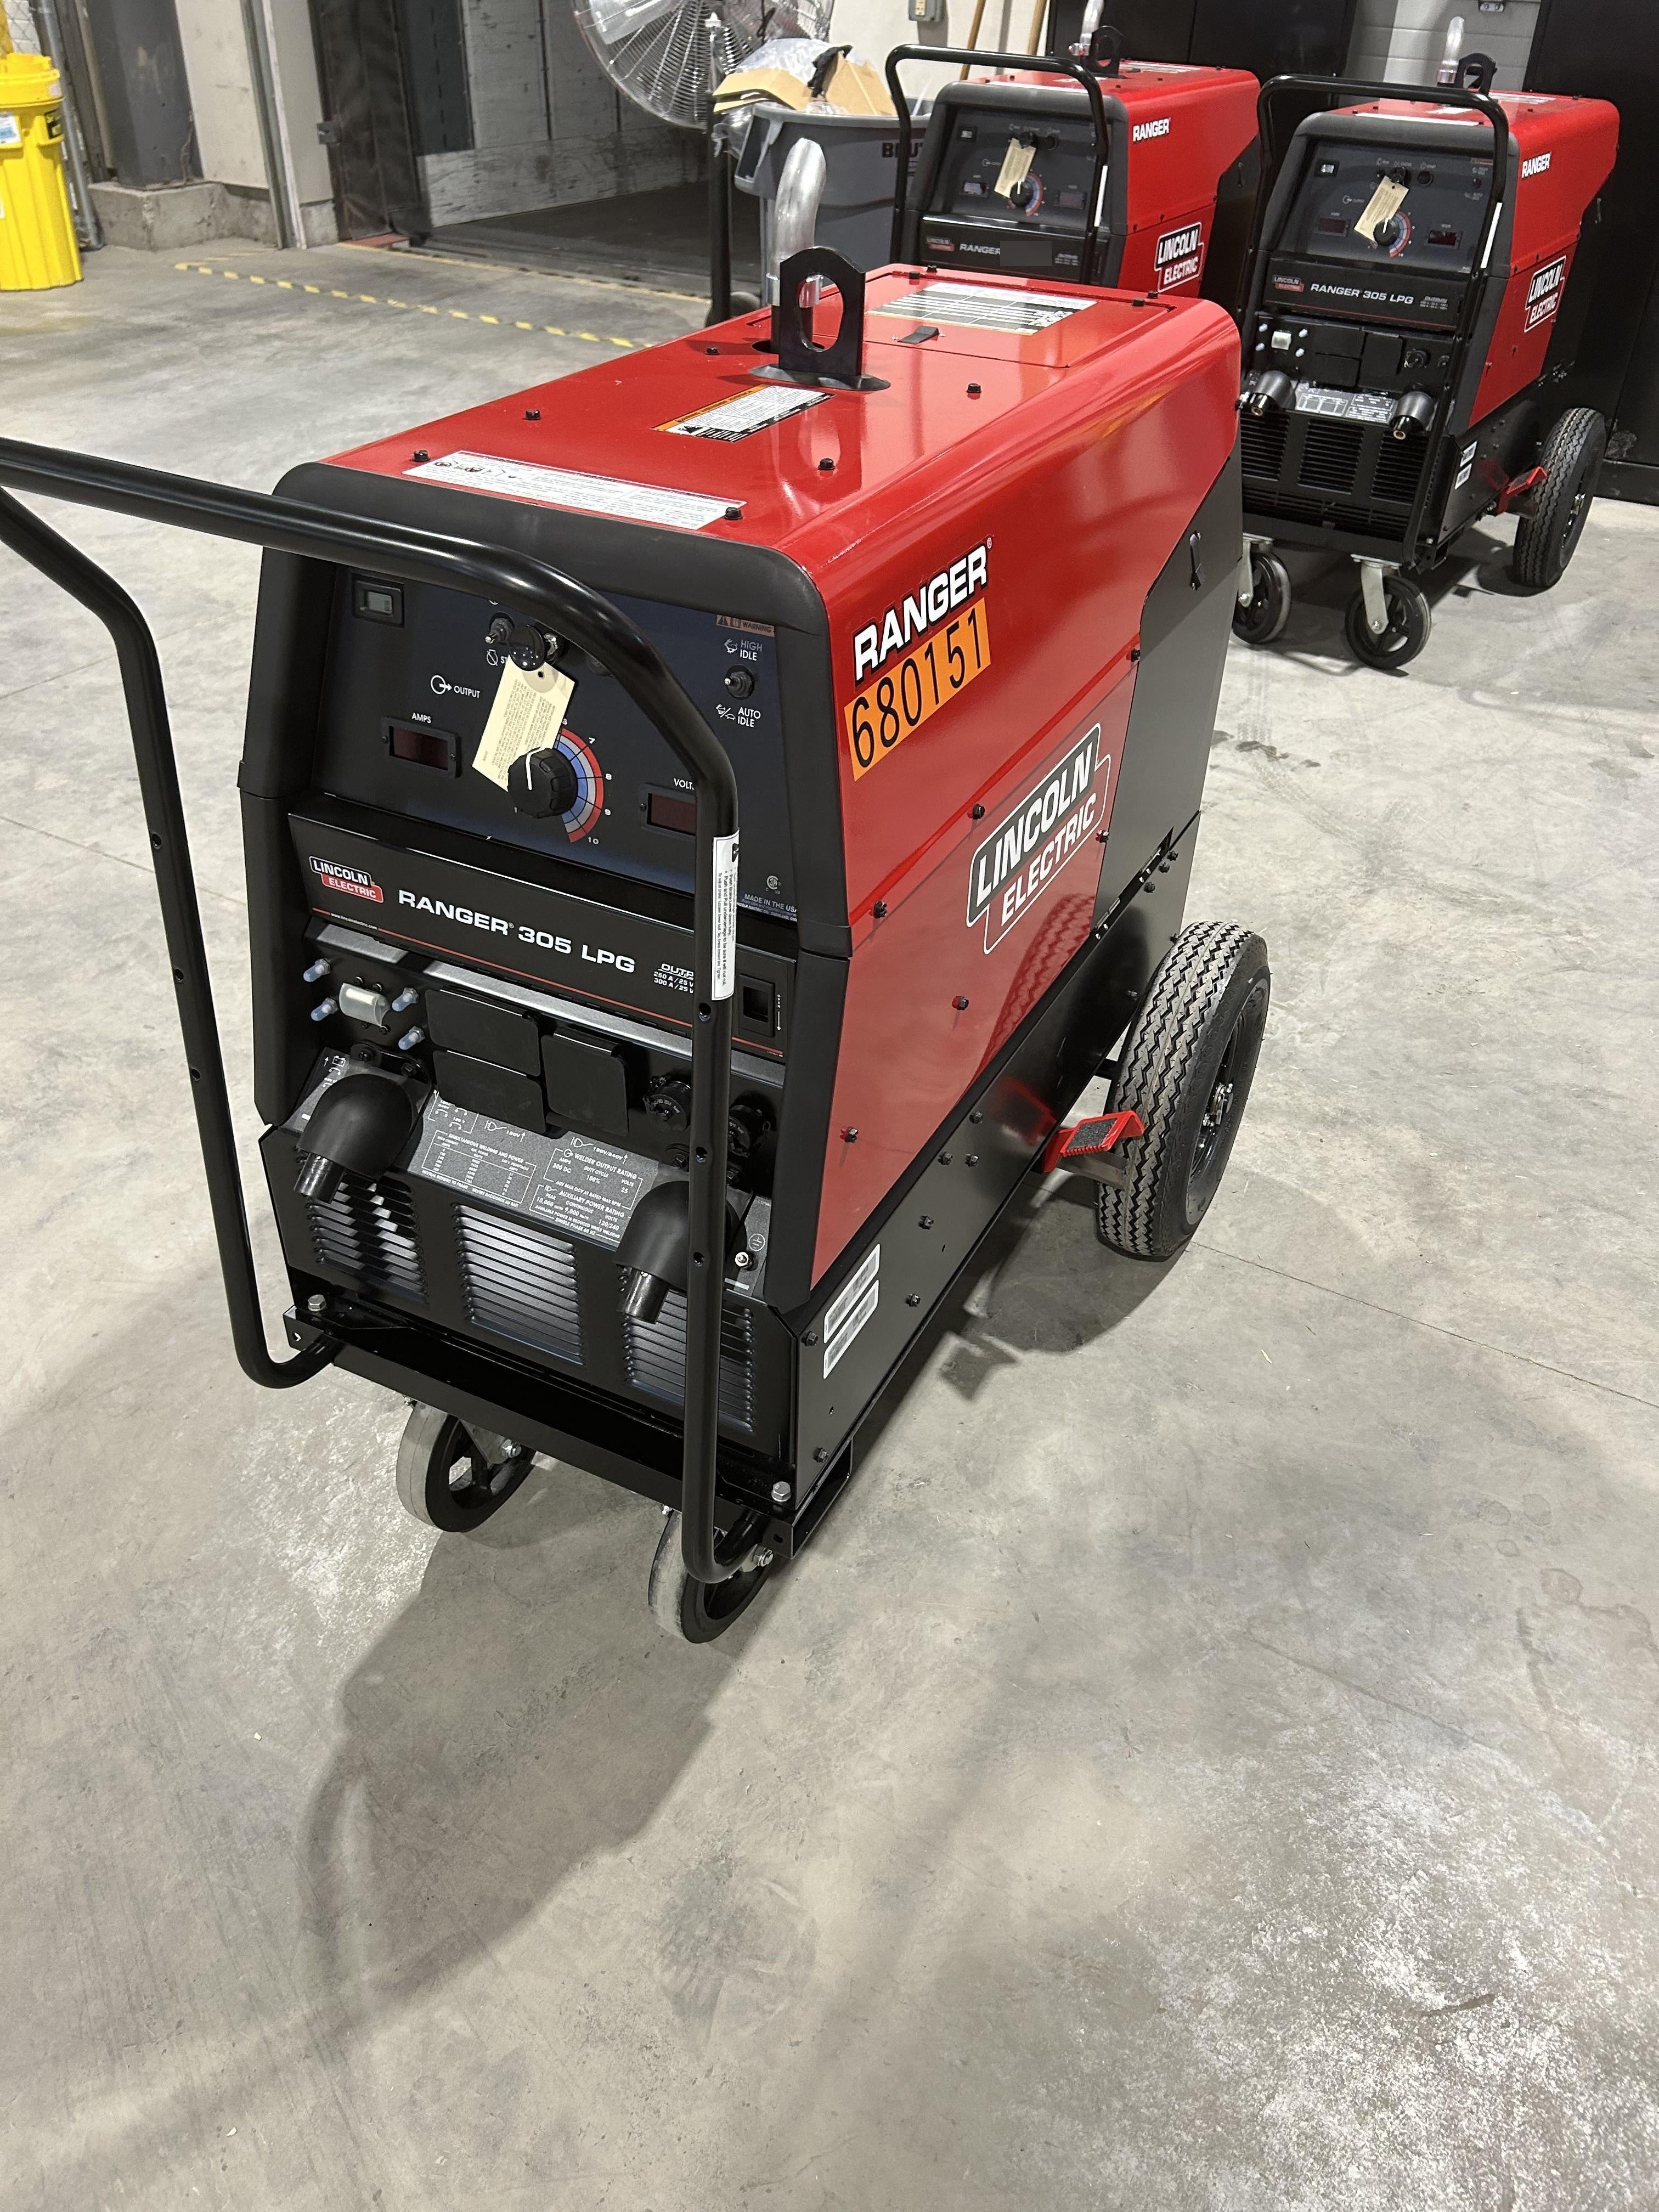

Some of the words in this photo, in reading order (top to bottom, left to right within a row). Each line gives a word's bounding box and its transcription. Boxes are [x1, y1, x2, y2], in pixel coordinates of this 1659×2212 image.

[1133, 119, 1169, 142] RANGER
[1521, 154, 1550, 178] RANGER
[1158, 229, 1199, 264] LINCOLN
[1164, 257, 1198, 285] ELECTRIC
[1528, 264, 1562, 303] LINCOLN
[1310, 284, 1361, 297] RANGER
[1363, 291, 1387, 300] 305
[1390, 294, 1414, 304] LPG
[1529, 292, 1558, 324] ELECTRIC
[854, 545, 987, 681] RANGER
[742, 620, 771, 633] WARNING
[741, 640, 763, 652] HIGH
[740, 649, 758, 661] IDLE
[454, 685, 481, 698] OUTPUT
[852, 609, 981, 768] 680151
[412, 713, 431, 724] AMPS
[738, 707, 761, 719] AUTO
[737, 716, 754, 727] IDLE
[674, 778, 695, 791] VOLT
[977, 742, 1092, 907] LINCOLN
[588, 836, 599, 845] 10
[1001, 792, 1097, 927] ELECTRIC
[313, 860, 368, 885] LINCOLN
[329, 877, 376, 898] ELECTRIC
[744, 894, 763, 904] MADE
[772, 901, 785, 909] THE
[399, 889, 509, 935] RANGER
[518, 926, 572, 954] 305
[581, 944, 635, 973] LPG
[653, 971, 667, 979] 250
[661, 963, 693, 977] OUTP
[653, 978, 668, 986] 300
[508, 1154, 524, 1164] POWER
[552, 1163, 563, 1171] 300
[574, 1153, 596, 1165] WELDER
[596, 1161, 617, 1172] OUTPUT
[617, 1169, 637, 1180] RATING
[586, 1175, 600, 1184] 100%
[595, 1170, 610, 1178] CYCLE
[621, 1179, 634, 1187] VOLTS
[536, 1197, 554, 1207] 10,000
[558, 1190, 586, 1204] AUXILIARY
[585, 1199, 605, 1211] POWER
[605, 1207, 625, 1218] RATING
[566, 1200, 594, 1214] CONTINUOUS
[565, 1207, 580, 1216] 9,000
[605, 1214, 618, 1223] VOLTS
[534, 1205, 554, 1215] AVAILABLE
[554, 1211, 568, 1220] POWER
[573, 1218, 590, 1227] REDUCED
[603, 1228, 620, 1238] WELDING
[555, 1217, 570, 1226] SINGLE
[569, 1222, 584, 1231] PHASE
[599, 1219, 619, 1231] 120/240
